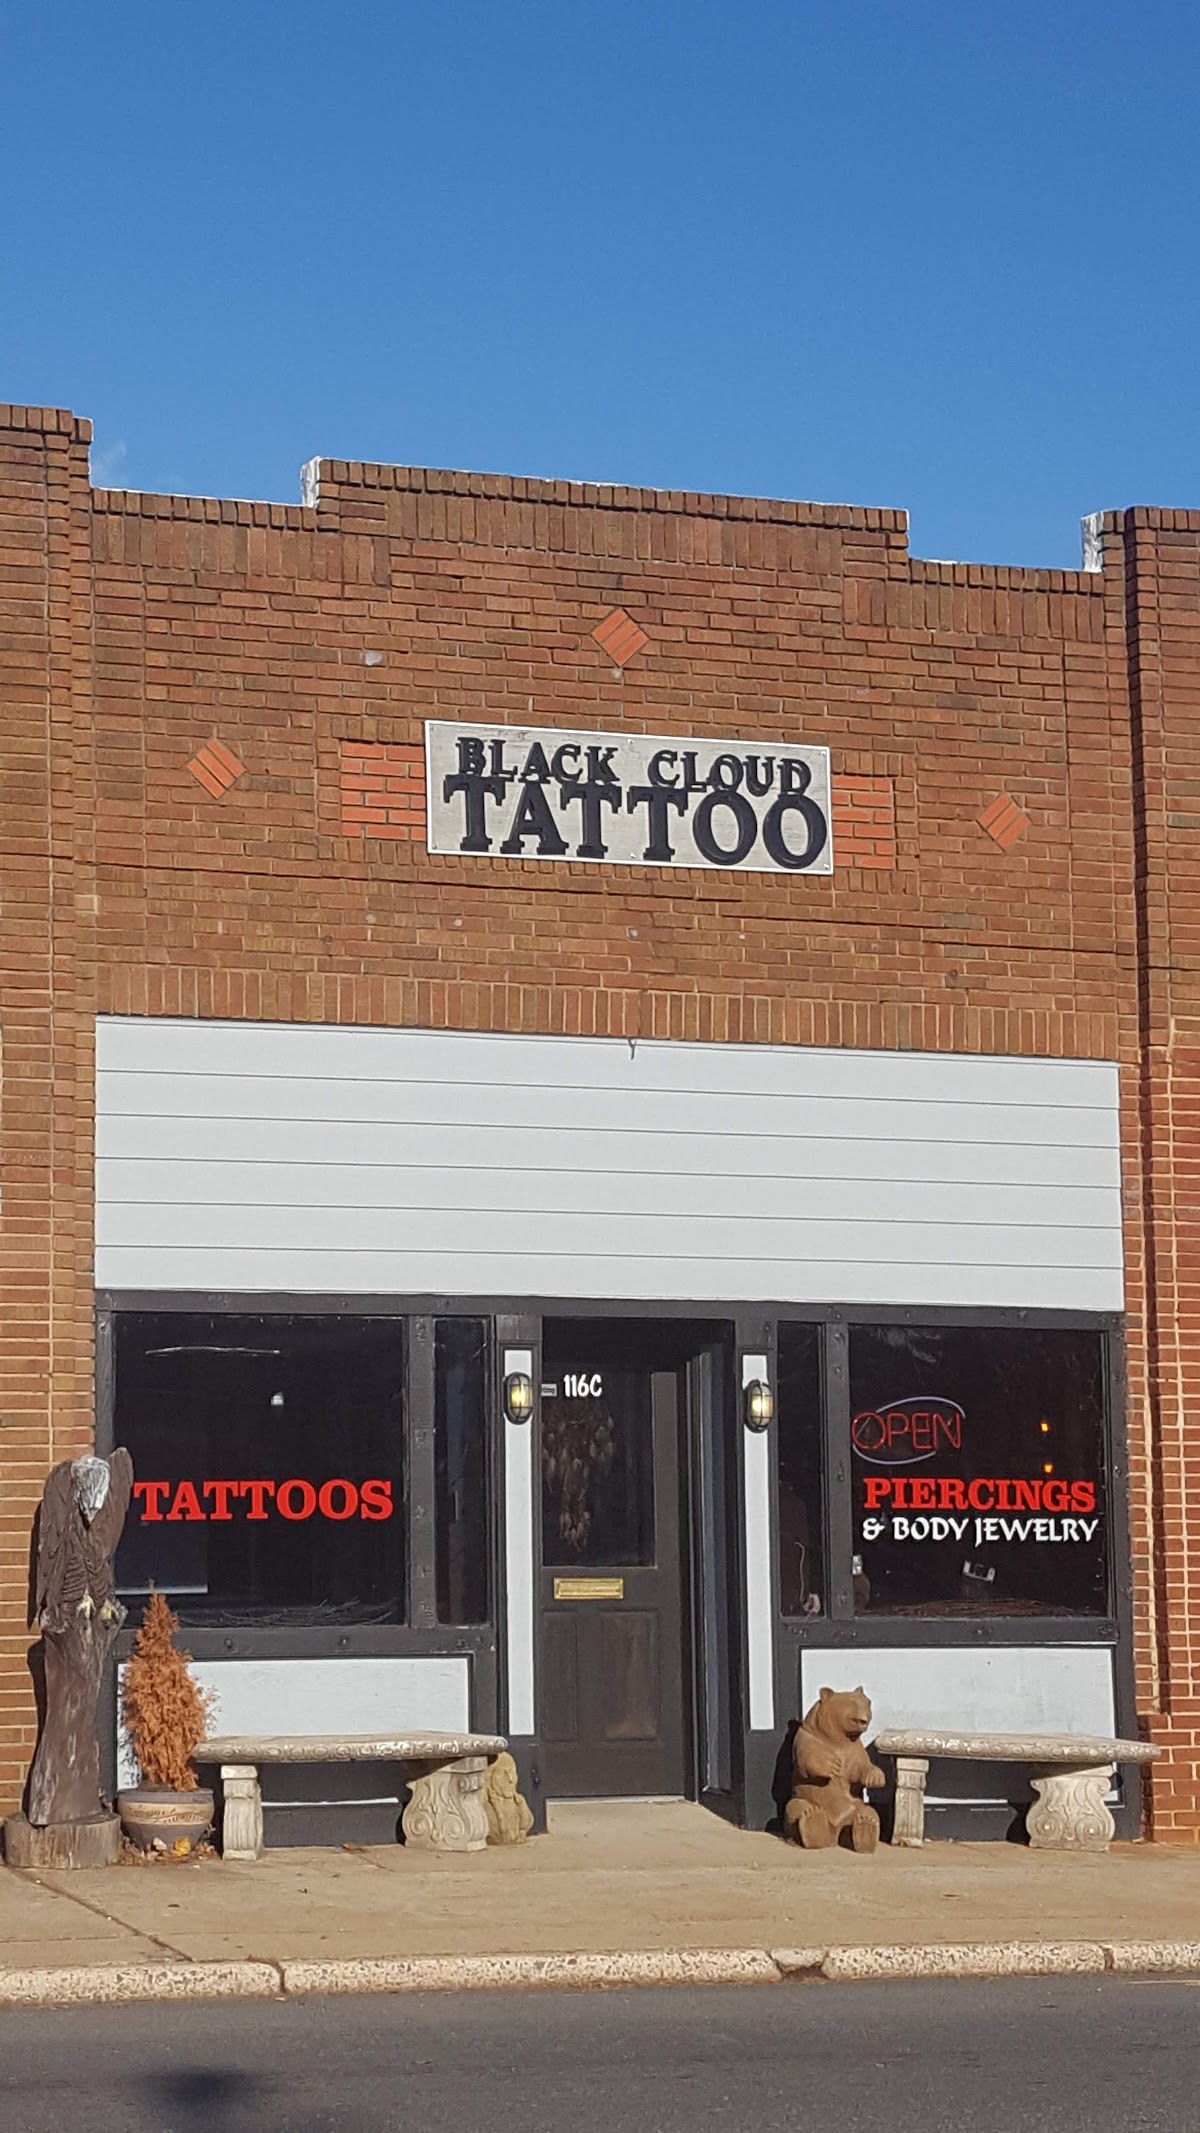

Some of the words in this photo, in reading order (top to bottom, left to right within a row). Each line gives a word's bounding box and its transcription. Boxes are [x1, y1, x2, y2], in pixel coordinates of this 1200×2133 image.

[456, 736, 620, 784] BLACK
[647, 750, 811, 798] CLOUD
[443, 774, 827, 869] TATTOO
[563, 1373, 603, 1398] 116C
[852, 1412, 962, 1450] OPEN
[133, 1479, 393, 1520] TATTOOS
[863, 1478, 1095, 1512] PIERCINGS
[862, 1516, 885, 1541] &
[892, 1516, 969, 1541] BODY
[974, 1518, 1099, 1548] JEWELRY
